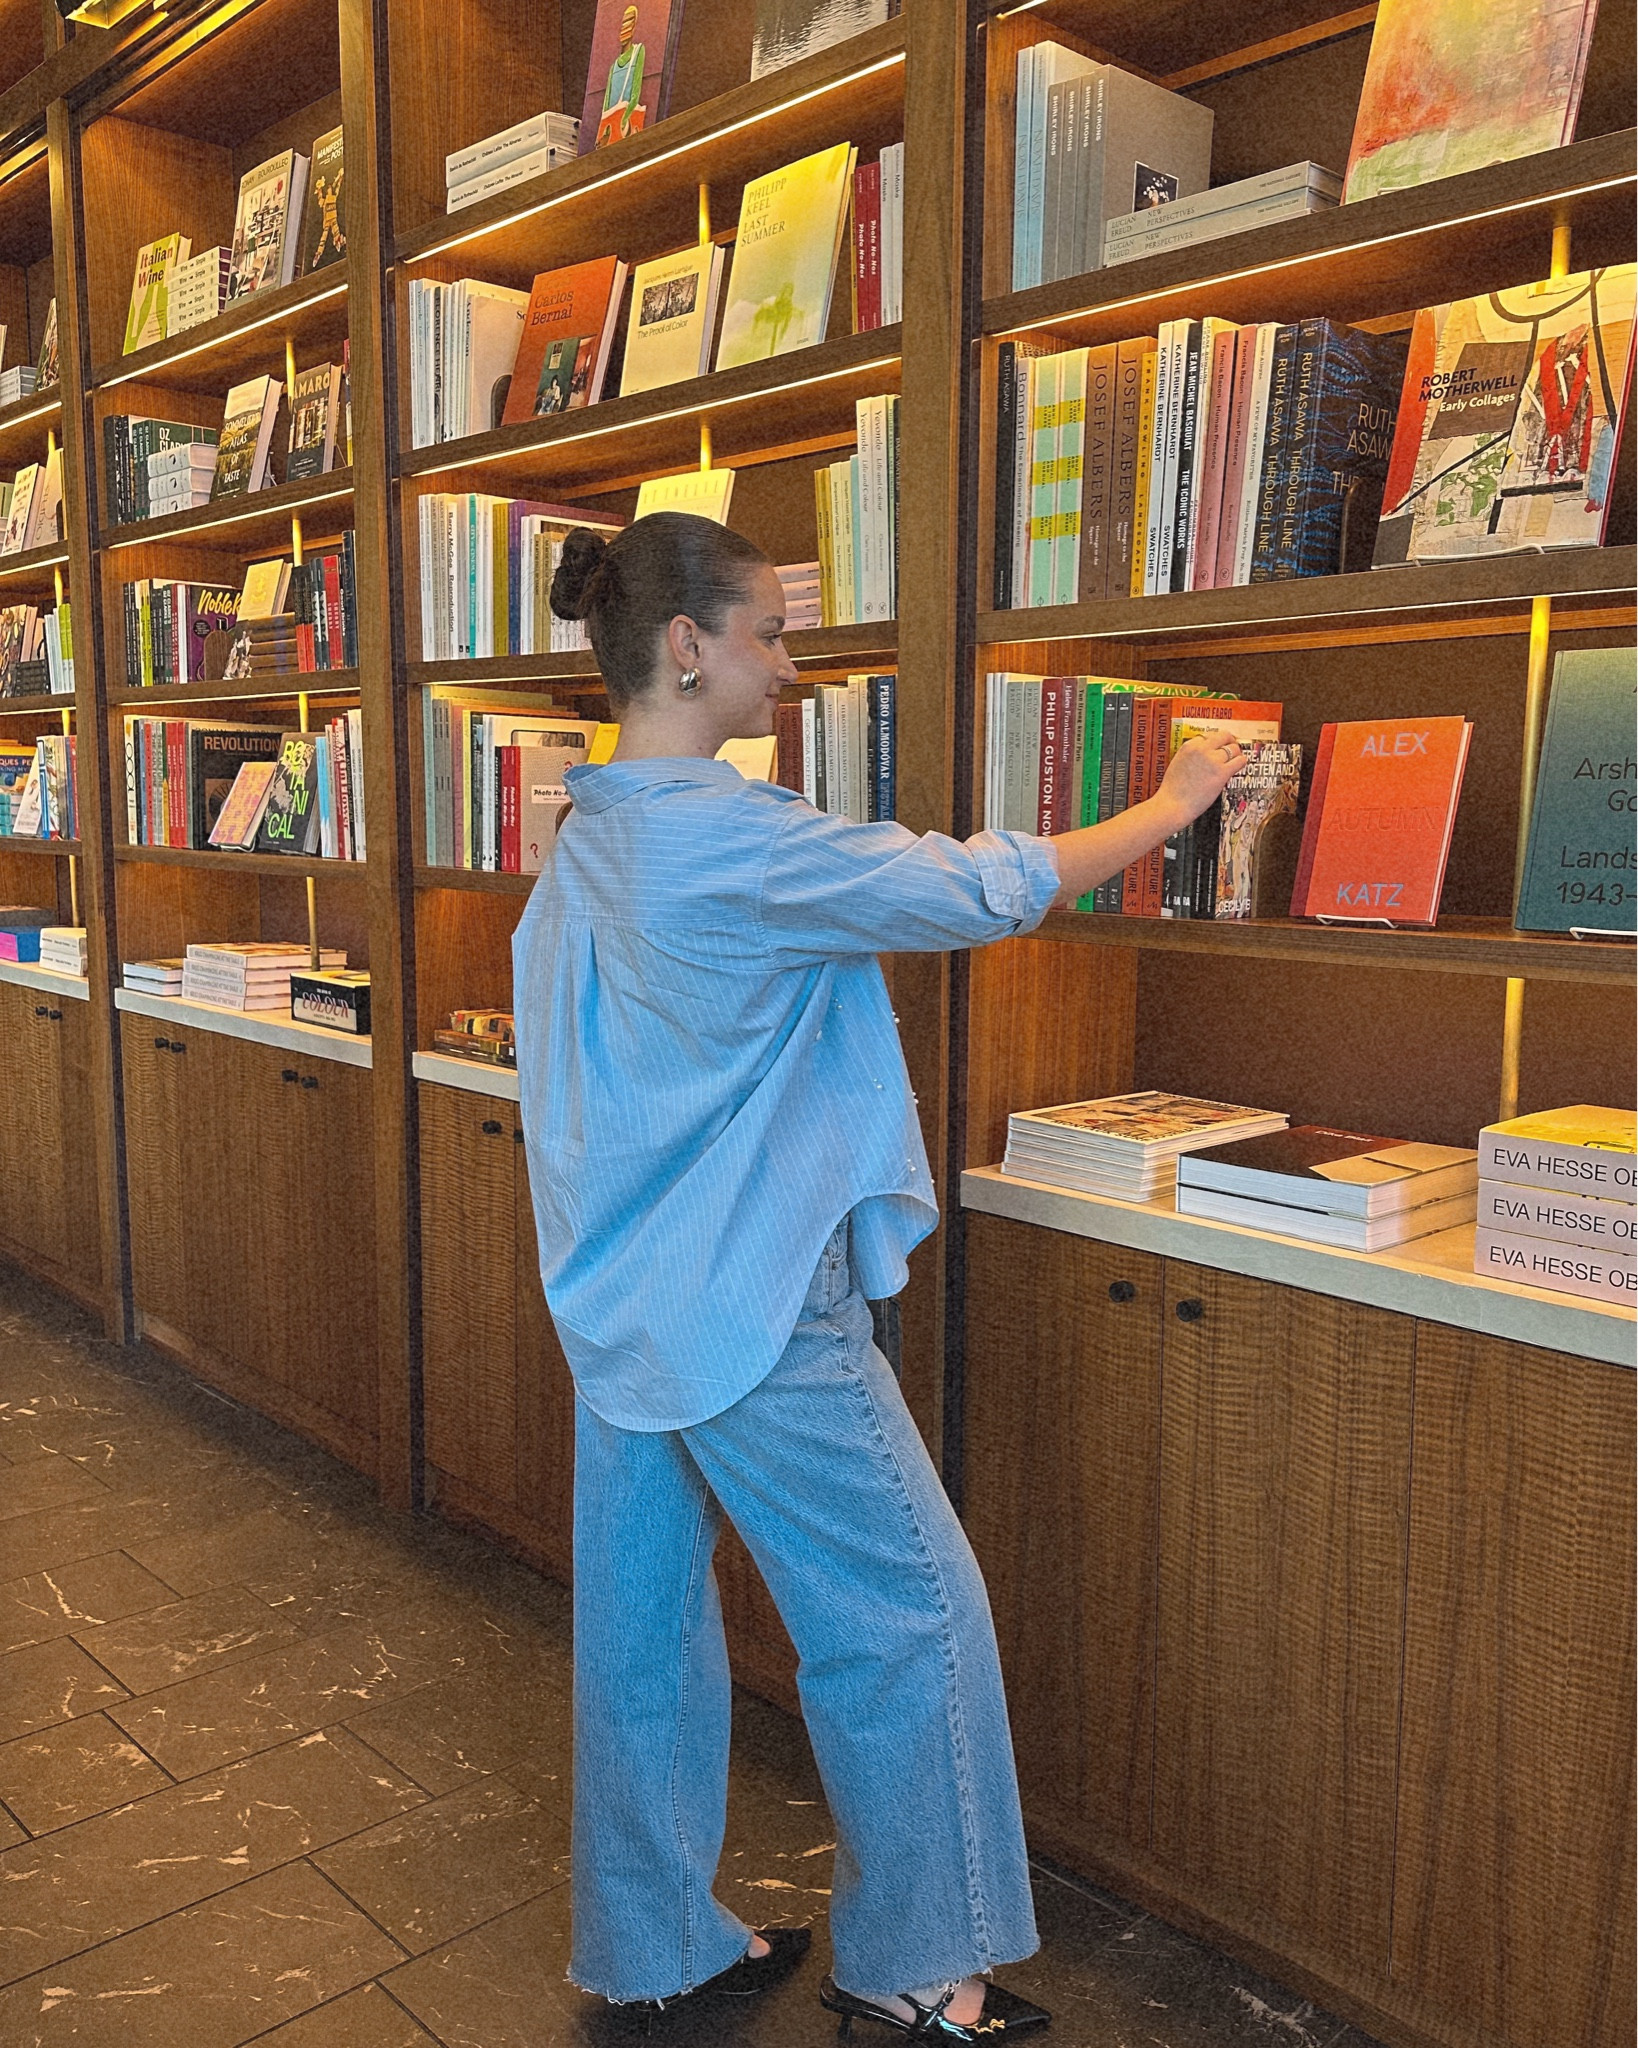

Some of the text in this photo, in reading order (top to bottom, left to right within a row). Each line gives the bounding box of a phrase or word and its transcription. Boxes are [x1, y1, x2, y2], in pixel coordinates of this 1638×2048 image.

[1050, 95, 1058, 131] SHIRLEY
[747, 177, 787, 203] PHILIPP
[746, 198, 772, 217] KEEL
[1146, 206, 1196, 227] PERSPECTIVES
[741, 221, 786, 247] SUMMER
[743, 214, 769, 234] LAST
[869, 219, 877, 244] Photo
[1111, 215, 1137, 229] LUCIAN
[1111, 225, 1132, 238] FREUD
[1108, 248, 1130, 260] FREUD
[1109, 239, 1135, 252] LUCIAN
[1144, 231, 1194, 250] PERSPECTIVES
[140, 246, 174, 269] Italian
[138, 268, 165, 289] Wine
[533, 290, 574, 309] Carlos
[530, 303, 573, 326] Bernal
[637, 330, 648, 340] The
[648, 326, 665, 337] Proof
[671, 319, 689, 330] Color
[1002, 354, 1011, 414] RUTH ASAWA
[1274, 358, 1288, 394] RUTH
[1298, 352, 1313, 389] RUTH
[1421, 367, 1478, 389] ROBERT
[1418, 374, 1518, 402] MOTHERWELL
[1017, 372, 1027, 441] Bonnard
[1210, 344, 1227, 470] Francis Bacon Human Presence
[1236, 401, 1244, 425] Human
[1439, 391, 1516, 413] Early Collages
[1269, 397, 1285, 447] ASAWA
[1293, 391, 1308, 441] ASAWA
[1357, 402, 1396, 432] RUTH
[159, 427, 171, 441] OZ
[229, 433, 248, 448] ATLAS
[859, 412, 868, 452] Yevonde
[874, 410, 883, 450] Yevonde
[1089, 364, 1108, 519] JOSEF ALBERS
[1118, 358, 1137, 515] JOSEF ALBERS
[1140, 413, 1148, 478] BOWLING
[1176, 351, 1199, 549] JEAN-MICHEL BASQUIAT THE ICONIC WORKS
[1232, 427, 1240, 466] Presence
[231, 454, 239, 465] OF
[861, 459, 869, 472] Life
[876, 458, 884, 471] Life
[1147, 347, 1167, 578] KATHERINE BERNHARDT SWATCHES
[1161, 344, 1183, 577] KATHERINE BERNHARDT SWATCHES
[223, 469, 240, 484] TASTE
[876, 472, 884, 484] and
[1261, 453, 1279, 520] THROUGH
[1285, 448, 1303, 516] THROUGH
[1134, 493, 1143, 574] LANDSCAPE
[1257, 523, 1272, 553] LINE
[1281, 518, 1294, 549] LINE
[1046, 691, 1056, 741] PHILIP
[1061, 685, 1072, 763] Helen Frankenthaler
[1181, 706, 1233, 719] LUCIANO FABRO
[204, 736, 280, 751] REVOLUTION
[880, 685, 891, 779] PEDRO ALMODÓVAR
[1360, 731, 1431, 757] ALEX
[1024, 732, 1032, 787] PERSPECTIVES
[1135, 714, 1147, 783] LUCIANO FABRO
[1260, 750, 1289, 764] WHEN,
[1043, 744, 1054, 806] GUSTON
[1247, 763, 1276, 775] OFTEN
[1275, 763, 1295, 775] AND
[1573, 757, 1637, 780] Arsh
[1248, 777, 1278, 789] WHOM
[291, 790, 309, 815] NI
[1148, 713, 1168, 896] LUCIANO FABRO SCULPTURE
[268, 812, 295, 840] CAL
[1326, 806, 1441, 832] AUTUMN
[1336, 882, 1404, 906] KATZ
[302, 991, 349, 1019] COLOUR
[1493, 1148, 1607, 1183] EVA HESSE
[1493, 1198, 1606, 1234] EVA HESSE
[1490, 1245, 1602, 1283] EVA HESSE
